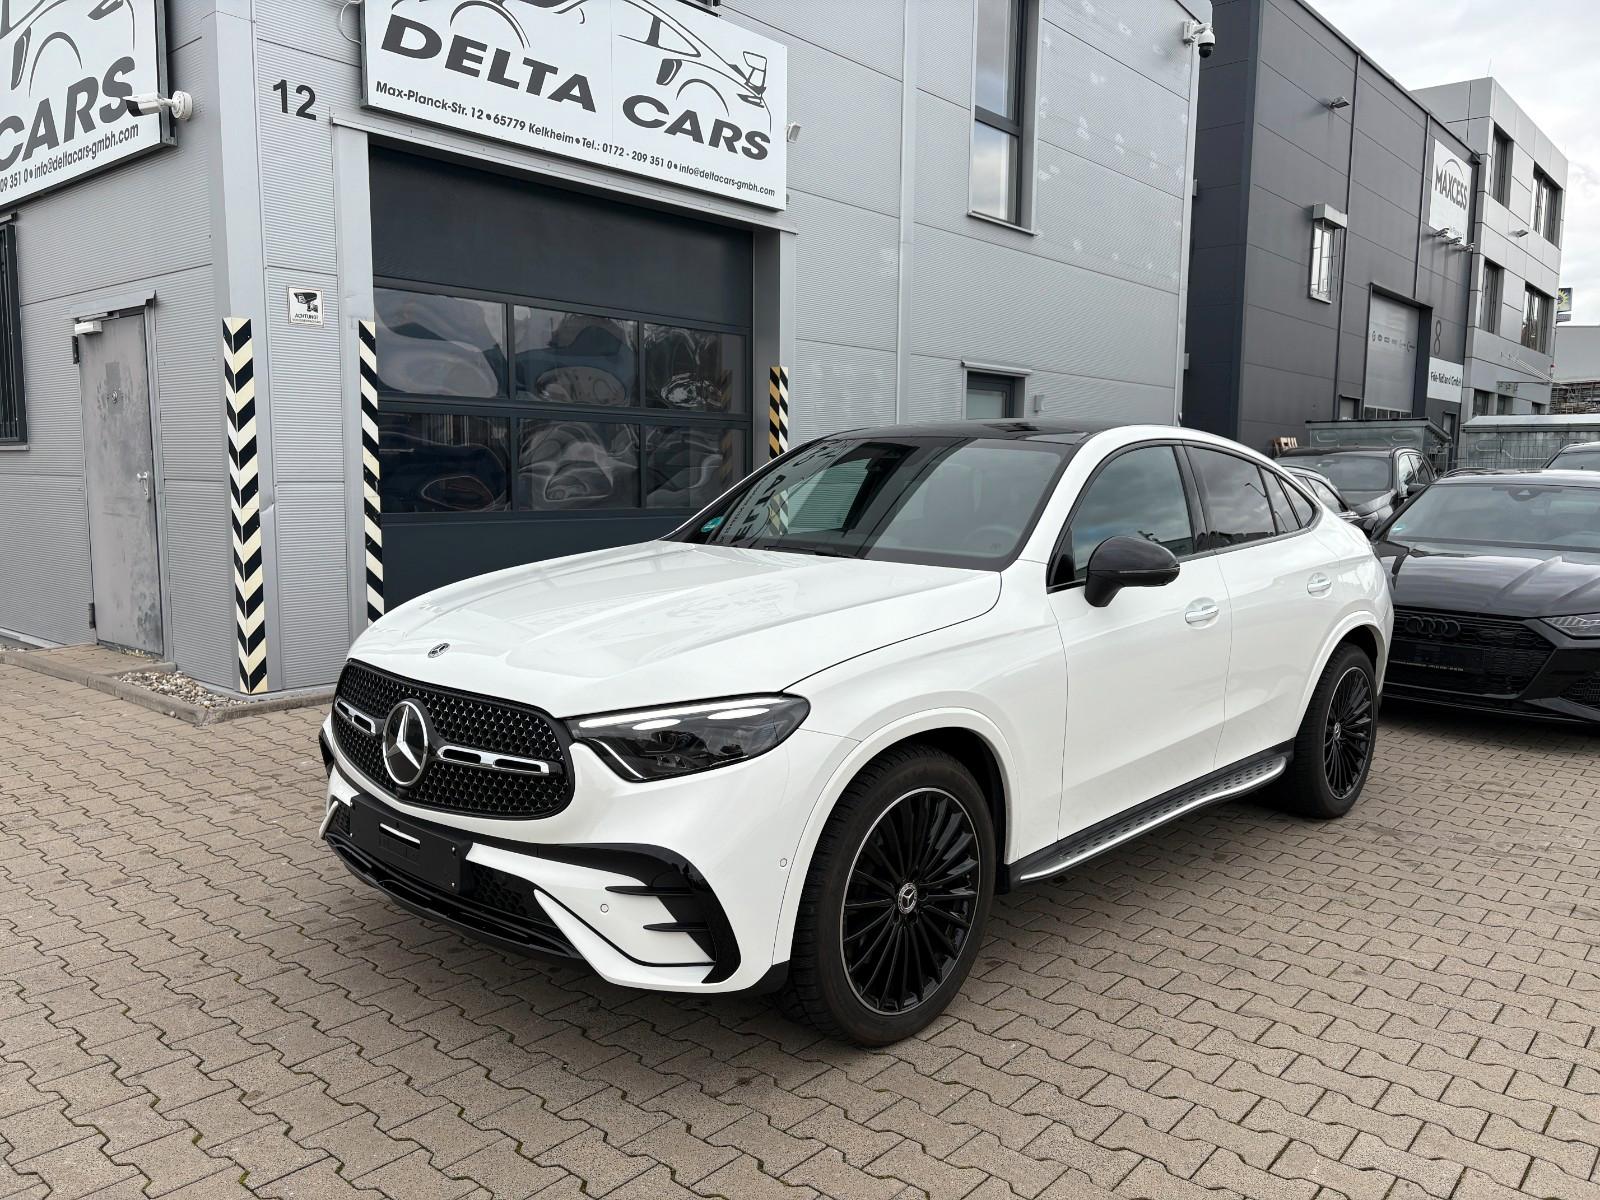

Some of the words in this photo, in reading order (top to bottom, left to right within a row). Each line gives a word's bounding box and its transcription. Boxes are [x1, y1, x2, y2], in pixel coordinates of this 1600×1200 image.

[0, 56, 135, 171] CARS
[273, 79, 317, 120] 12
[381, 14, 596, 113] DELTA
[622, 94, 771, 161] CARS
[9, 170, 21, 189] 351
[23, 167, 29, 183] 0
[34, 123, 139, 179] info@deltacars-gmbh.com
[376, 81, 468, 116] Max-Planck-Str.
[471, 107, 483, 120] 12
[493, 114, 526, 131] 65779
[528, 123, 574, 144] Kelkheim
[581, 137, 600, 151] Tel.:
[602, 143, 625, 157] 0172
[631, 150, 648, 163] 209
[649, 155, 665, 168] 351
[667, 160, 673, 170] 0
[679, 163, 775, 197] info@deltacars-gmbh.com
[1435, 164, 1467, 211] MAXCESS
[1434, 320, 1442, 356] 8
